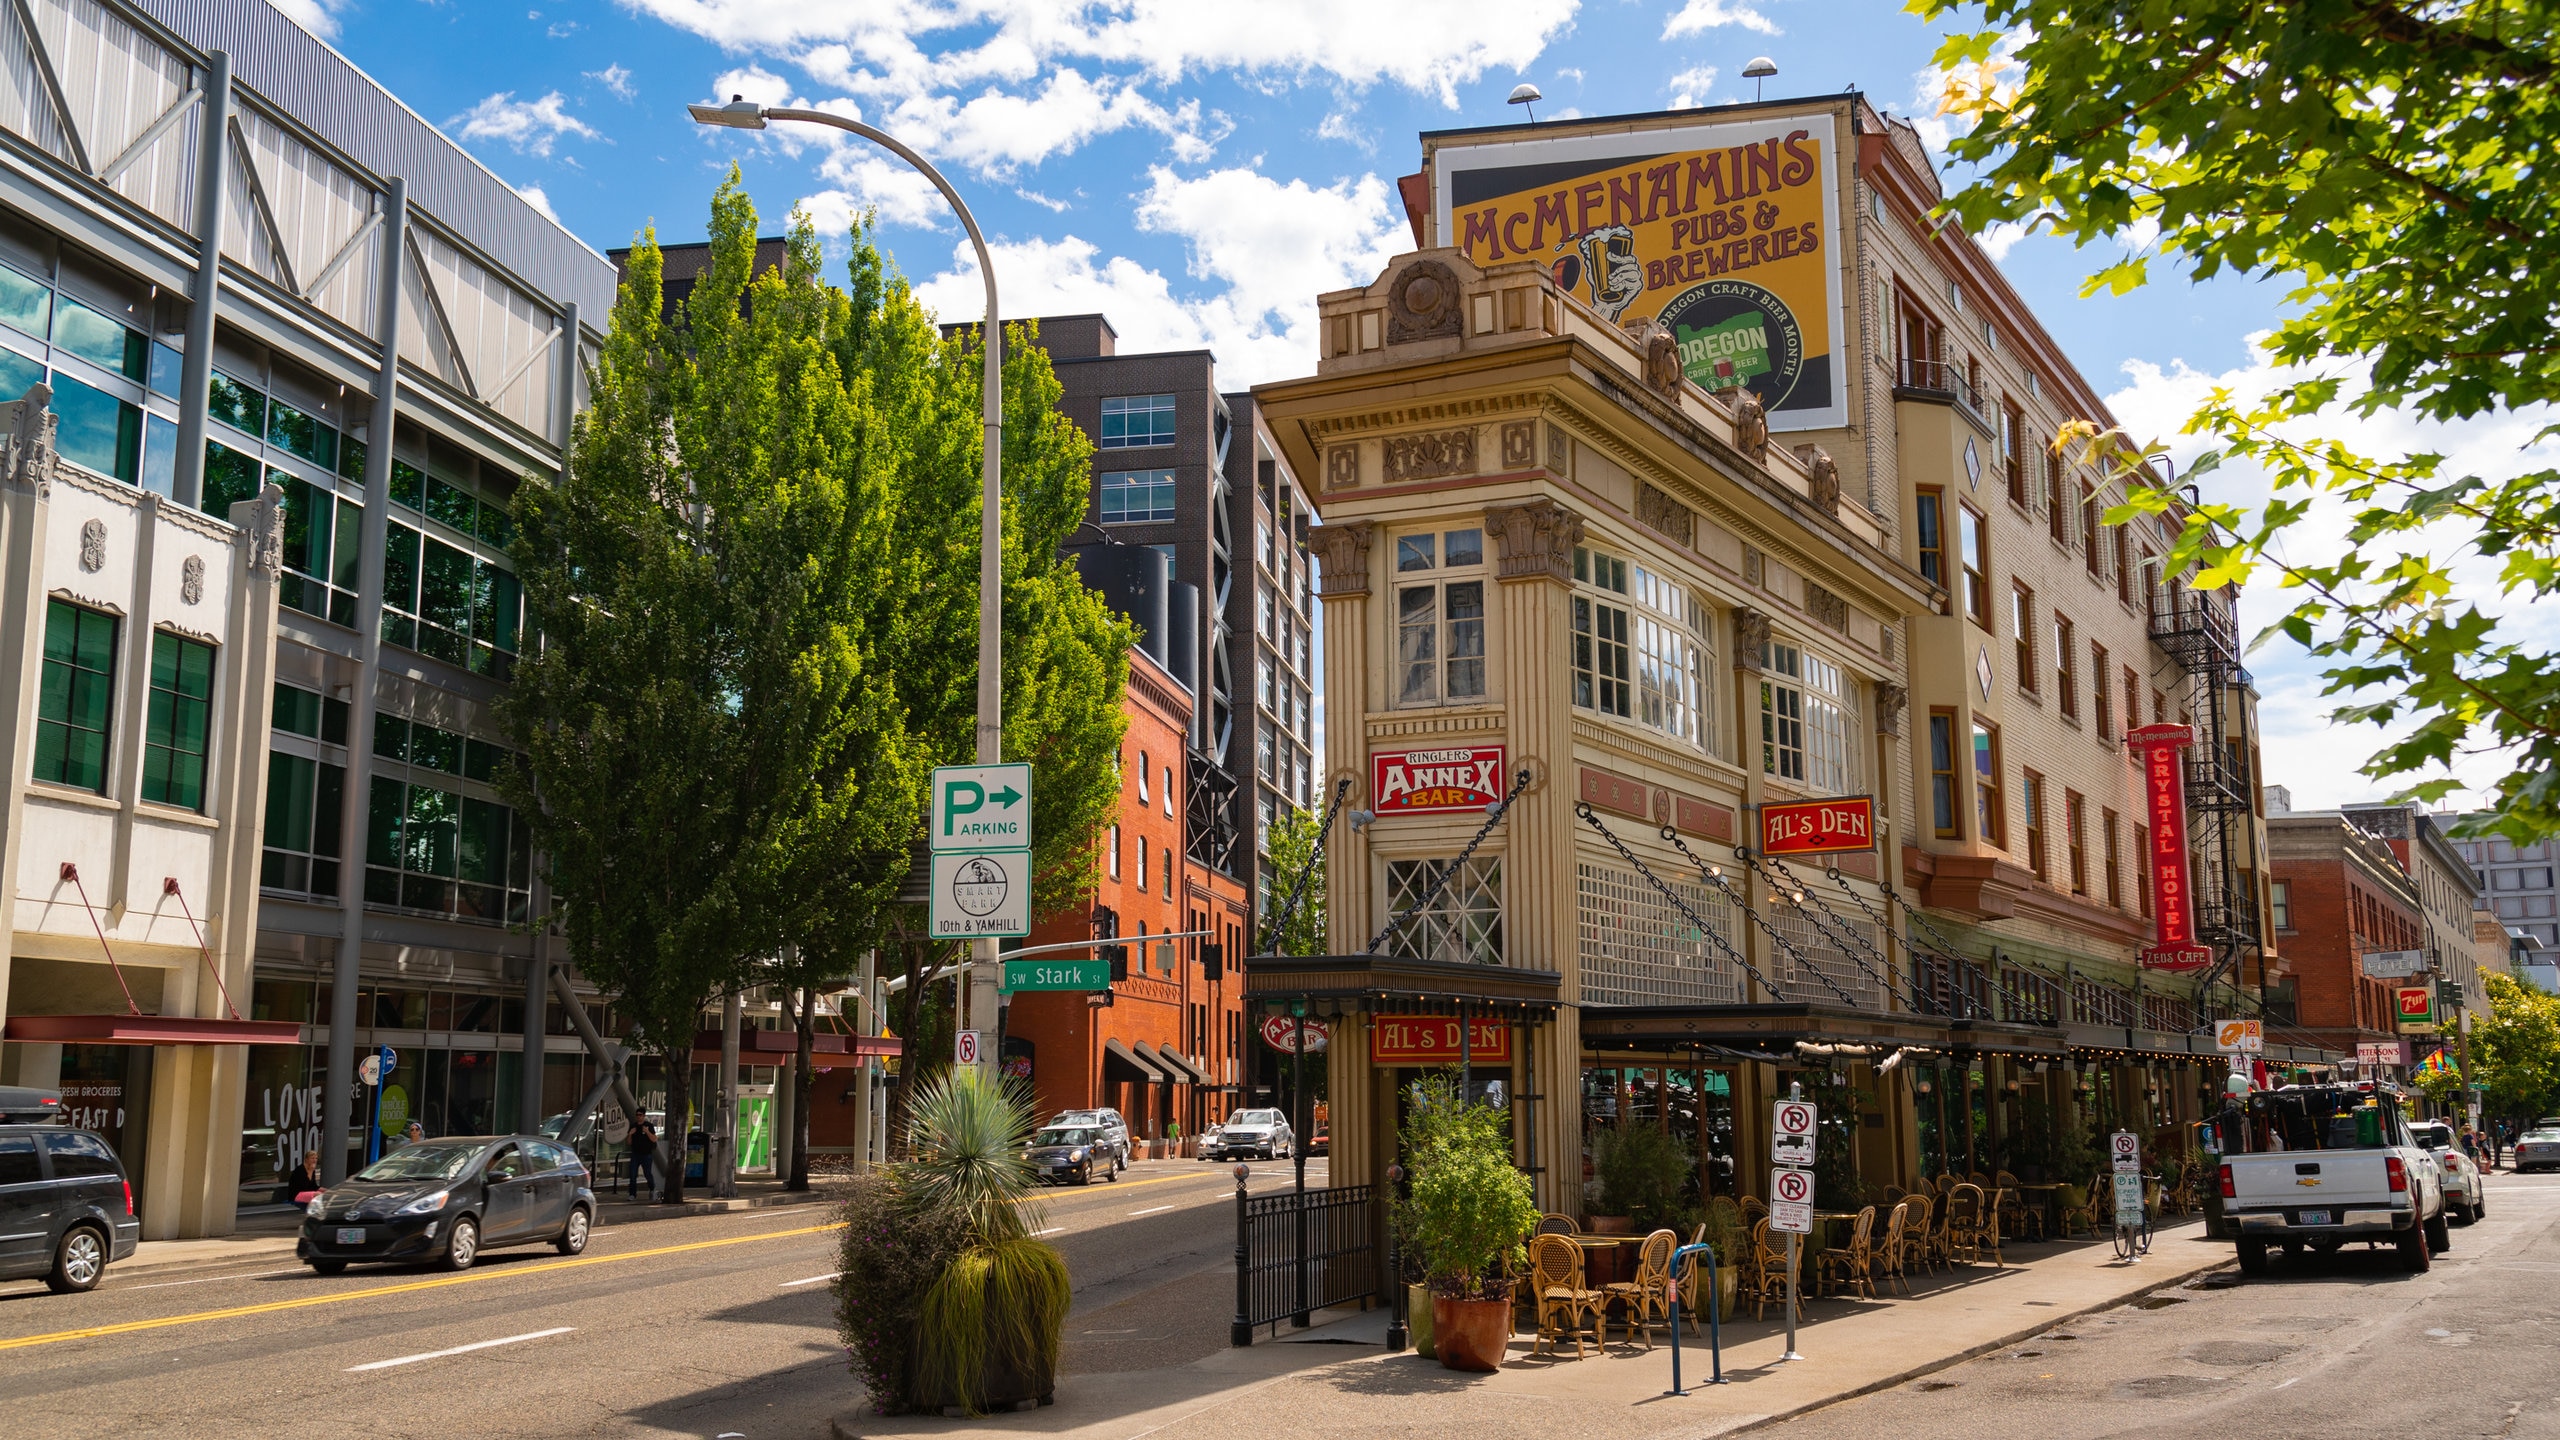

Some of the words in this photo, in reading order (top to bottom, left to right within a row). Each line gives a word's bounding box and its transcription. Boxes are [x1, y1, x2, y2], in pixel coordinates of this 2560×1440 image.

[1671, 205, 1745, 250] PUBS
[1753, 200, 1780, 231] &
[1646, 222, 1819, 291] BREWERIES
[1659, 288, 1706, 328] OREGON
[1711, 284, 1758, 299] CRAFT
[1759, 294, 1788, 324] BEER
[1783, 324, 1798, 377] MONTH
[1677, 326, 1769, 367] OREGON
[1687, 366, 1714, 379] CRAFT
[1735, 356, 1758, 369] BEER
[1409, 750, 1470, 764] RINGLERS
[1379, 760, 1499, 805] ANNEX
[1411, 789, 1465, 806] BAR
[2153, 747, 2176, 853] CRYSTAL
[1769, 813, 1814, 844] AL'S
[1820, 808, 1867, 837] DEN
[957, 886, 1003, 896] SMART
[962, 899, 997, 909] PARK
[2160, 865, 2182, 941] HOTEL
[940, 919, 961, 932] 10th
[965, 920, 972, 932] &
[975, 918, 1020, 932] YAMHILL
[2145, 951, 2174, 964] ZEUS
[2367, 959, 2416, 973] HOTEL
[1011, 973, 1027, 985] SW
[1036, 966, 1082, 984] Stark
[1092, 974, 1101, 984] St
[1383, 1023, 1436, 1049] AL'S
[1445, 1023, 1498, 1048] DEN
[2248, 1022, 2256, 1034] 2
[1287, 1034, 1316, 1047] BR
[81, 1087, 122, 1097] GROCERIES
[646, 1090, 667, 1110] LOVE
[263, 1083, 323, 1130] LOVE
[382, 1101, 405, 1110] WHOLE
[72, 1106, 109, 1130] FAST
[382, 1111, 406, 1121] FOODS
[273, 1125, 324, 1172] SHO
